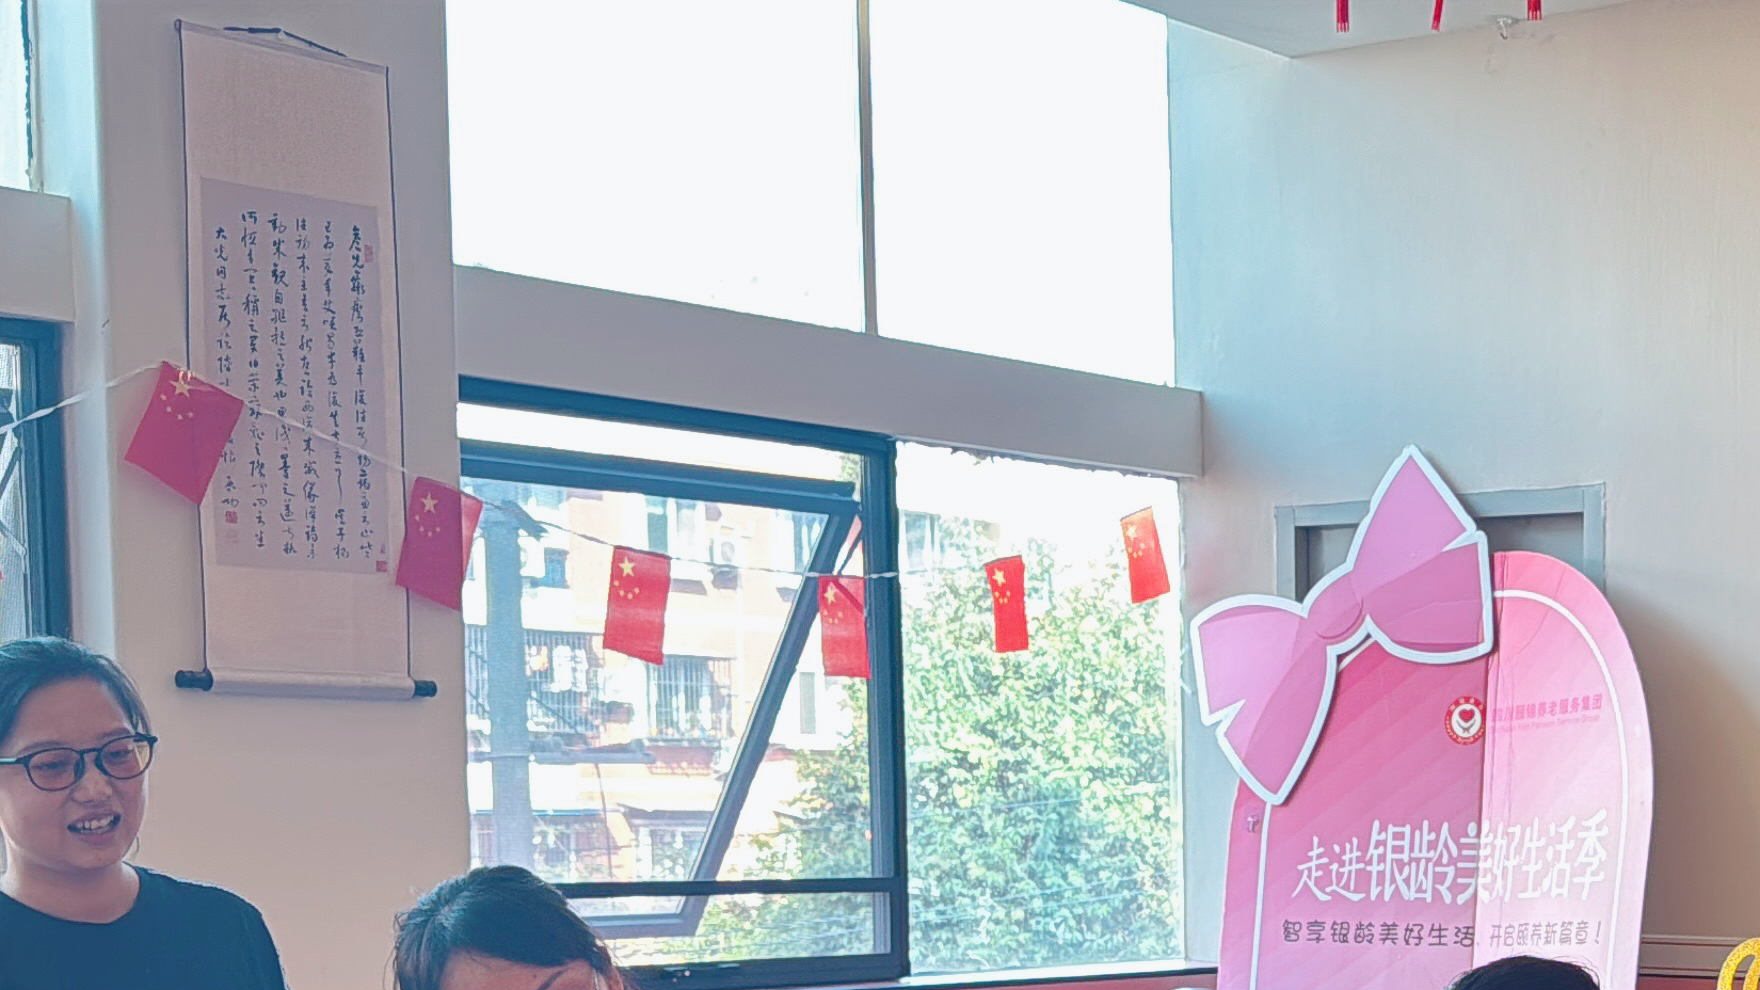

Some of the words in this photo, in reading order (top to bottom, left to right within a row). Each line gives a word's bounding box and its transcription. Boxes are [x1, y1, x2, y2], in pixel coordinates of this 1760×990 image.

[1291, 809, 1609, 905] 走进银龄美好生活季
